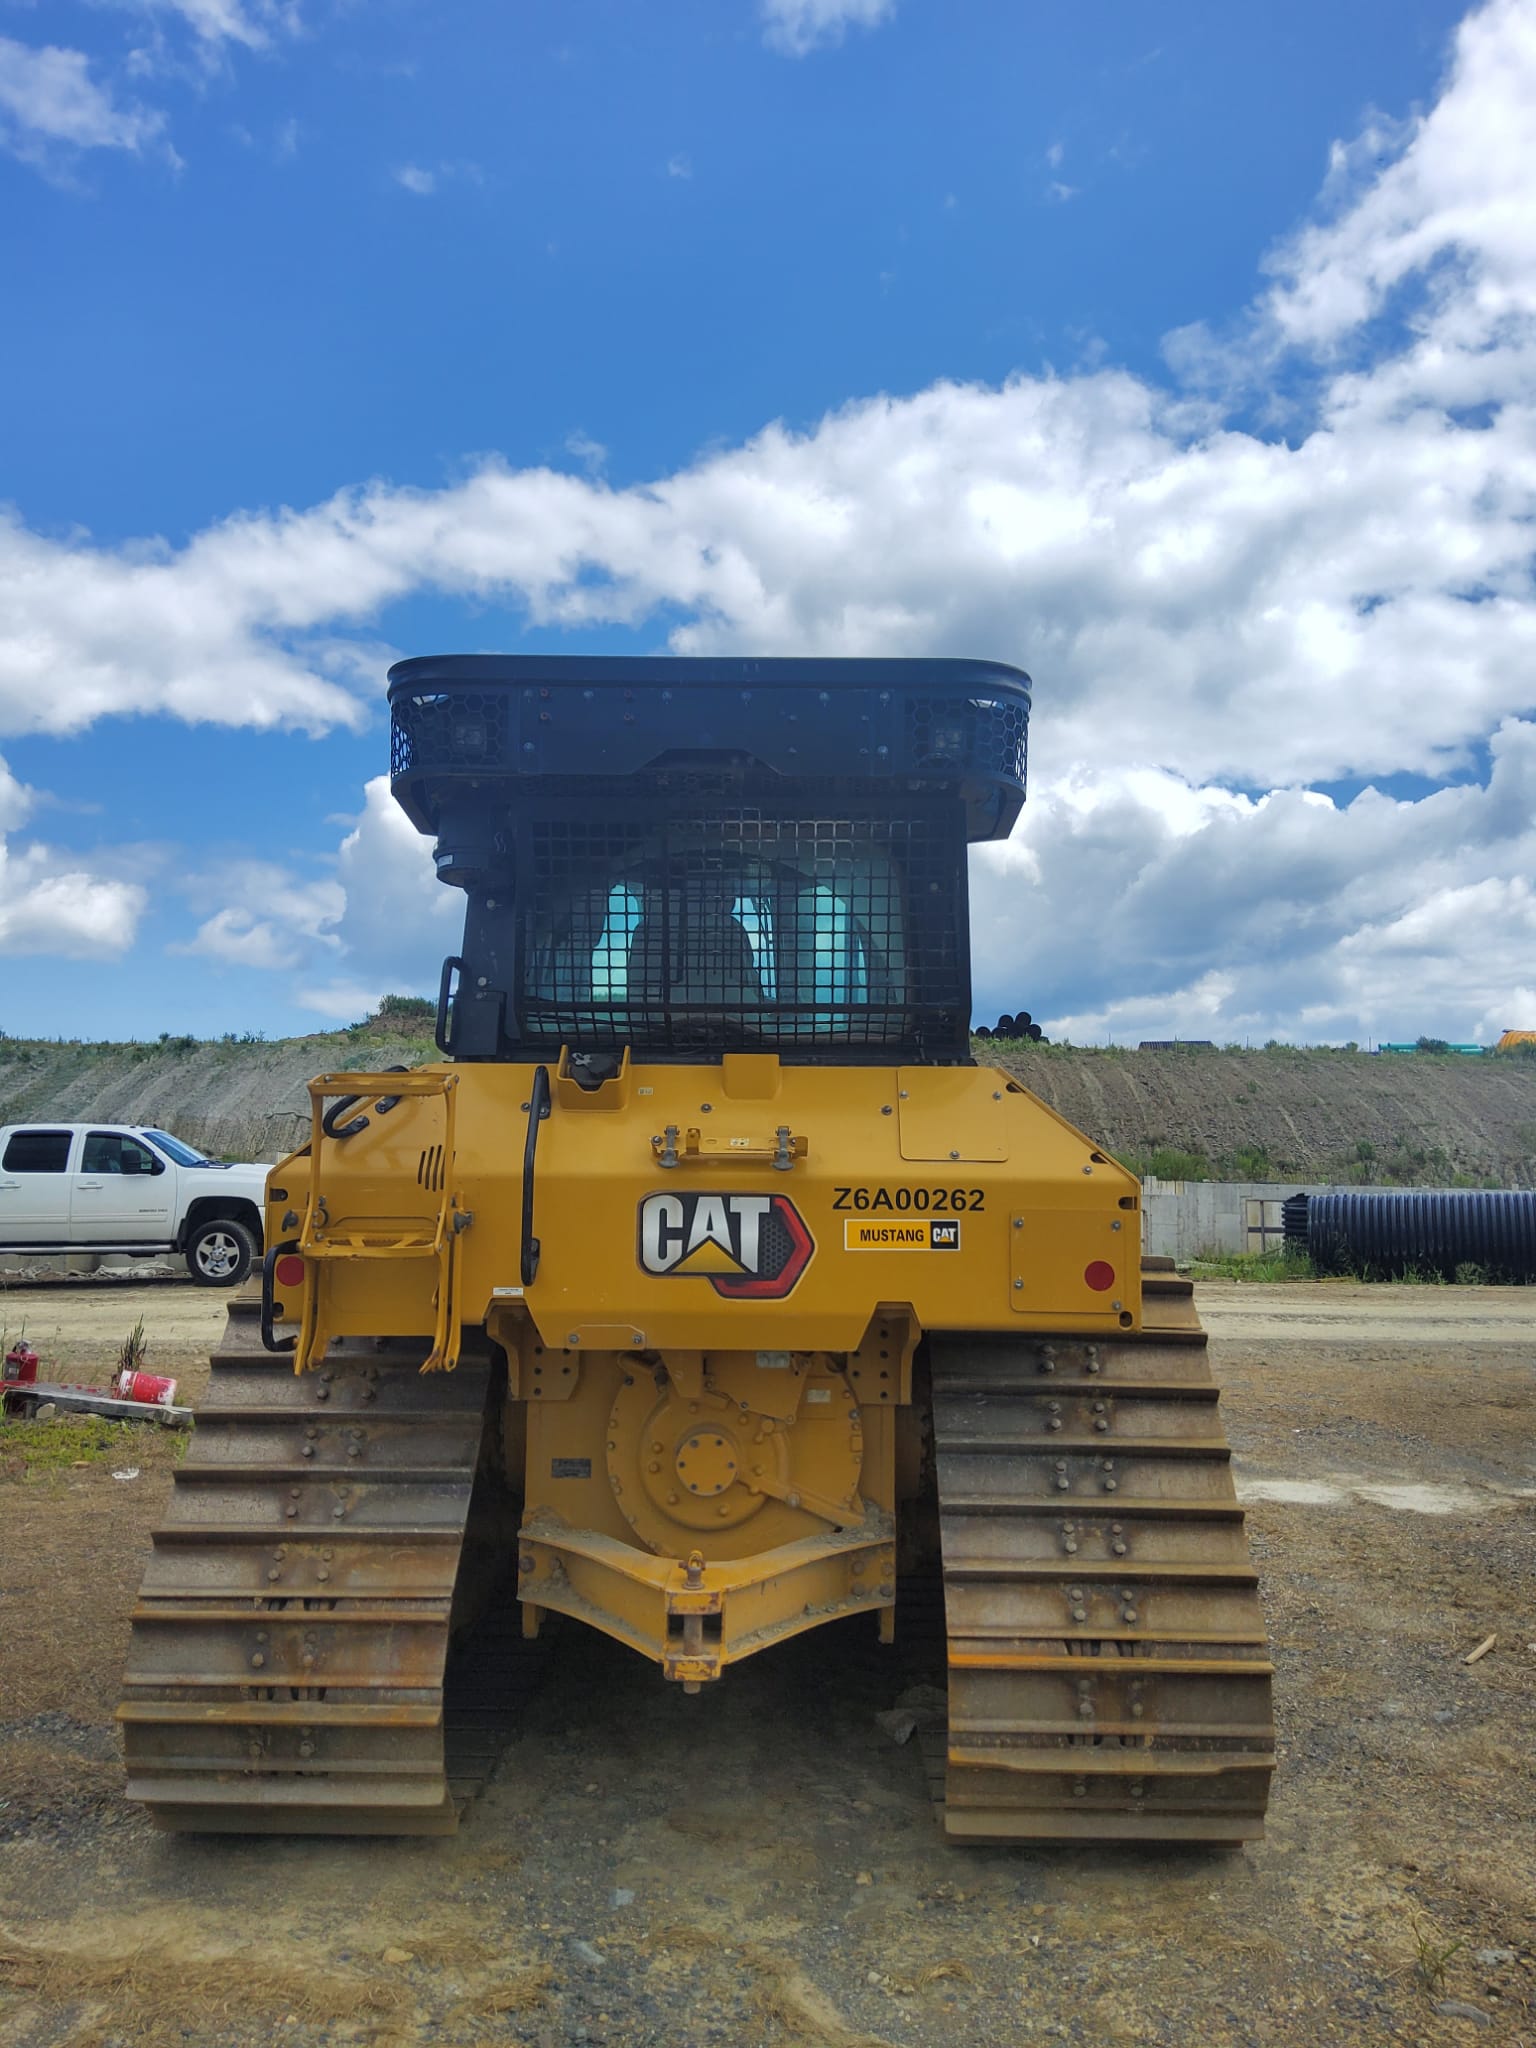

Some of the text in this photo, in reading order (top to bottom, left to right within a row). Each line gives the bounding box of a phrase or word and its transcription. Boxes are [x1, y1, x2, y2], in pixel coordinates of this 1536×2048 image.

[832, 1187, 985, 1211] Z6A00262
[642, 1194, 770, 1273] CAT
[860, 1227, 957, 1242] MUSTANG CAT
